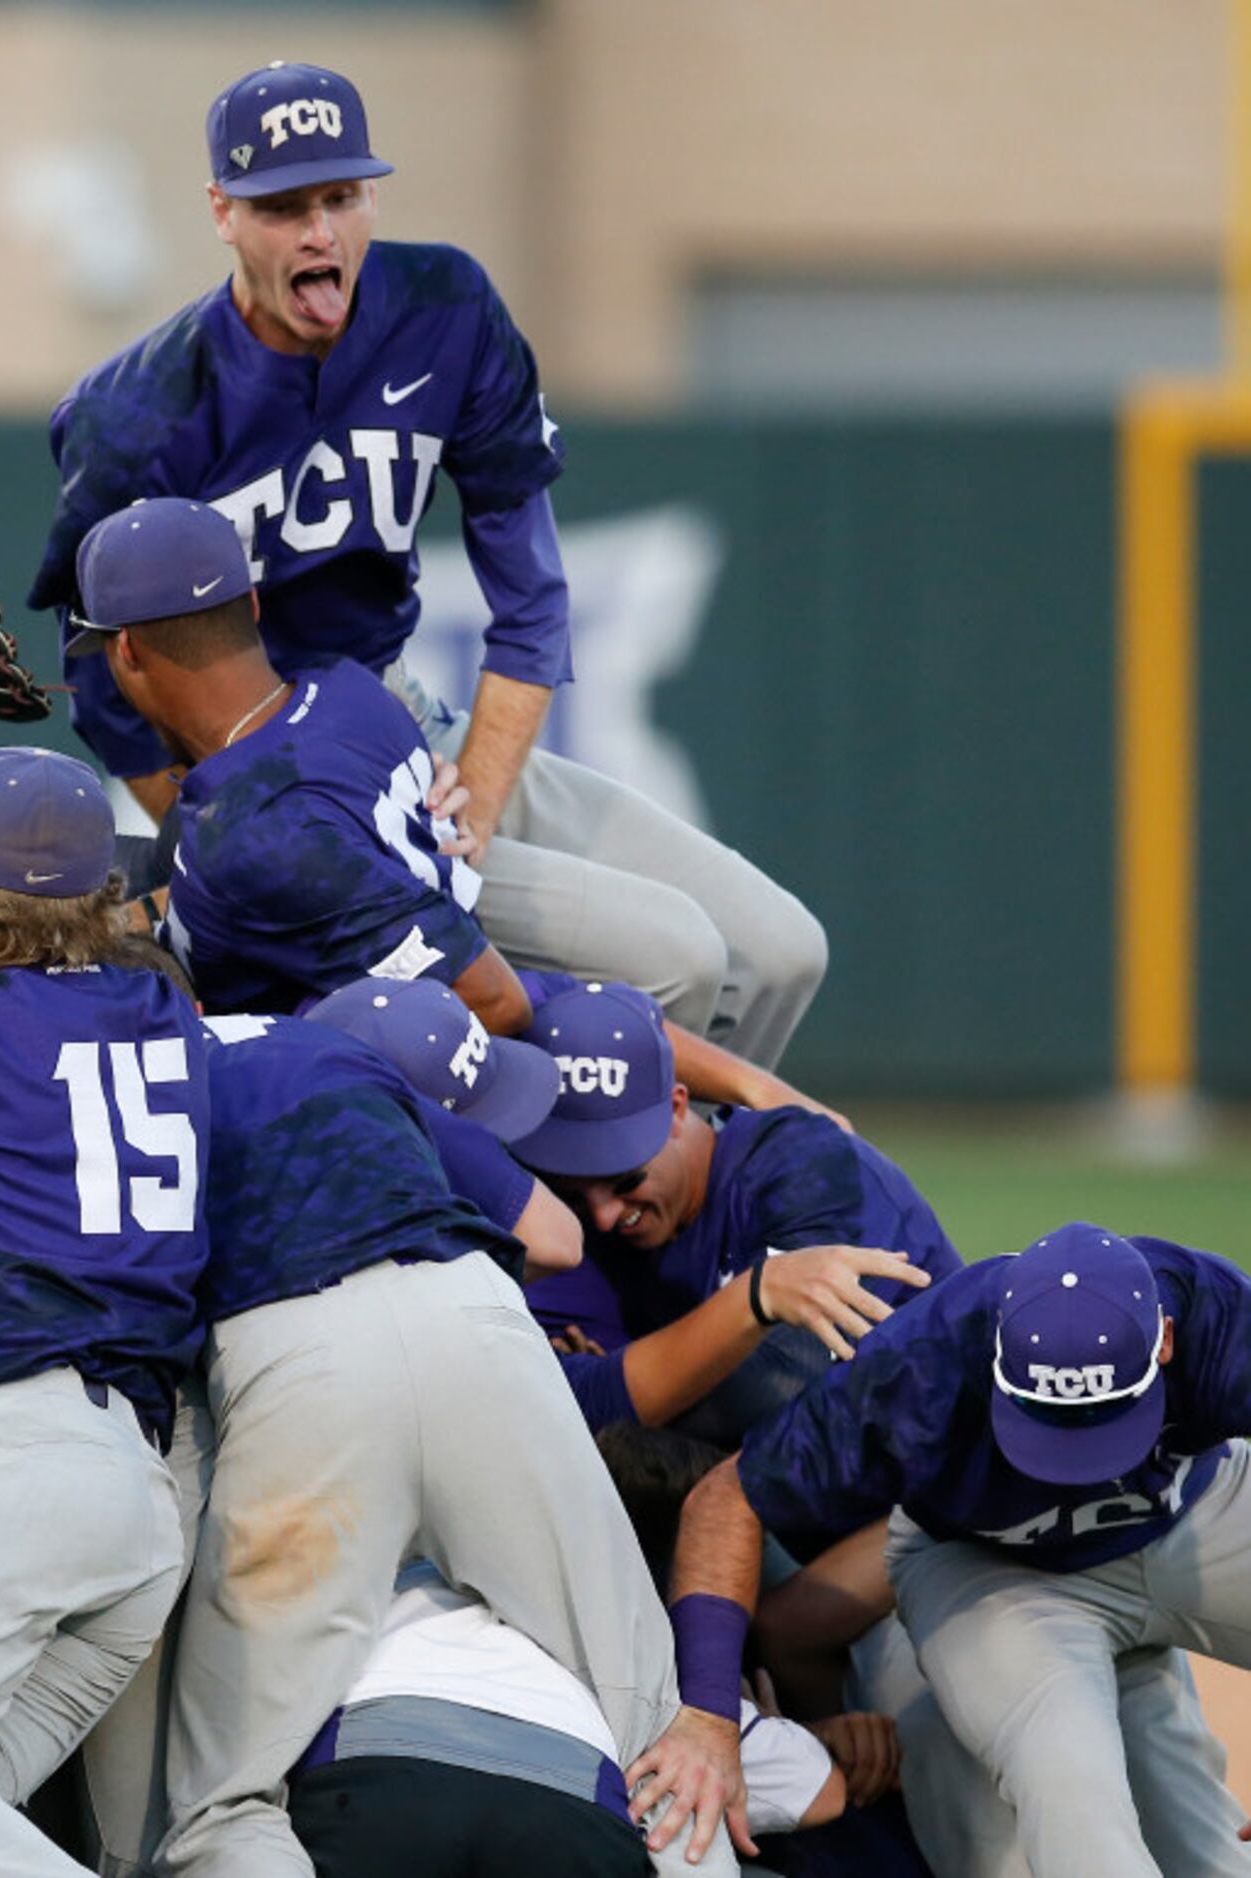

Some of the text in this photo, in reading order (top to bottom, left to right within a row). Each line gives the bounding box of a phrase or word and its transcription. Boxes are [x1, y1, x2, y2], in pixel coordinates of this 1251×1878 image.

[261, 98, 343, 150] TCU
[208, 428, 443, 584] TCU
[553, 1054, 630, 1098] TCU
[52, 1037, 199, 1234] 15
[1028, 1363, 1115, 1399] TCU
